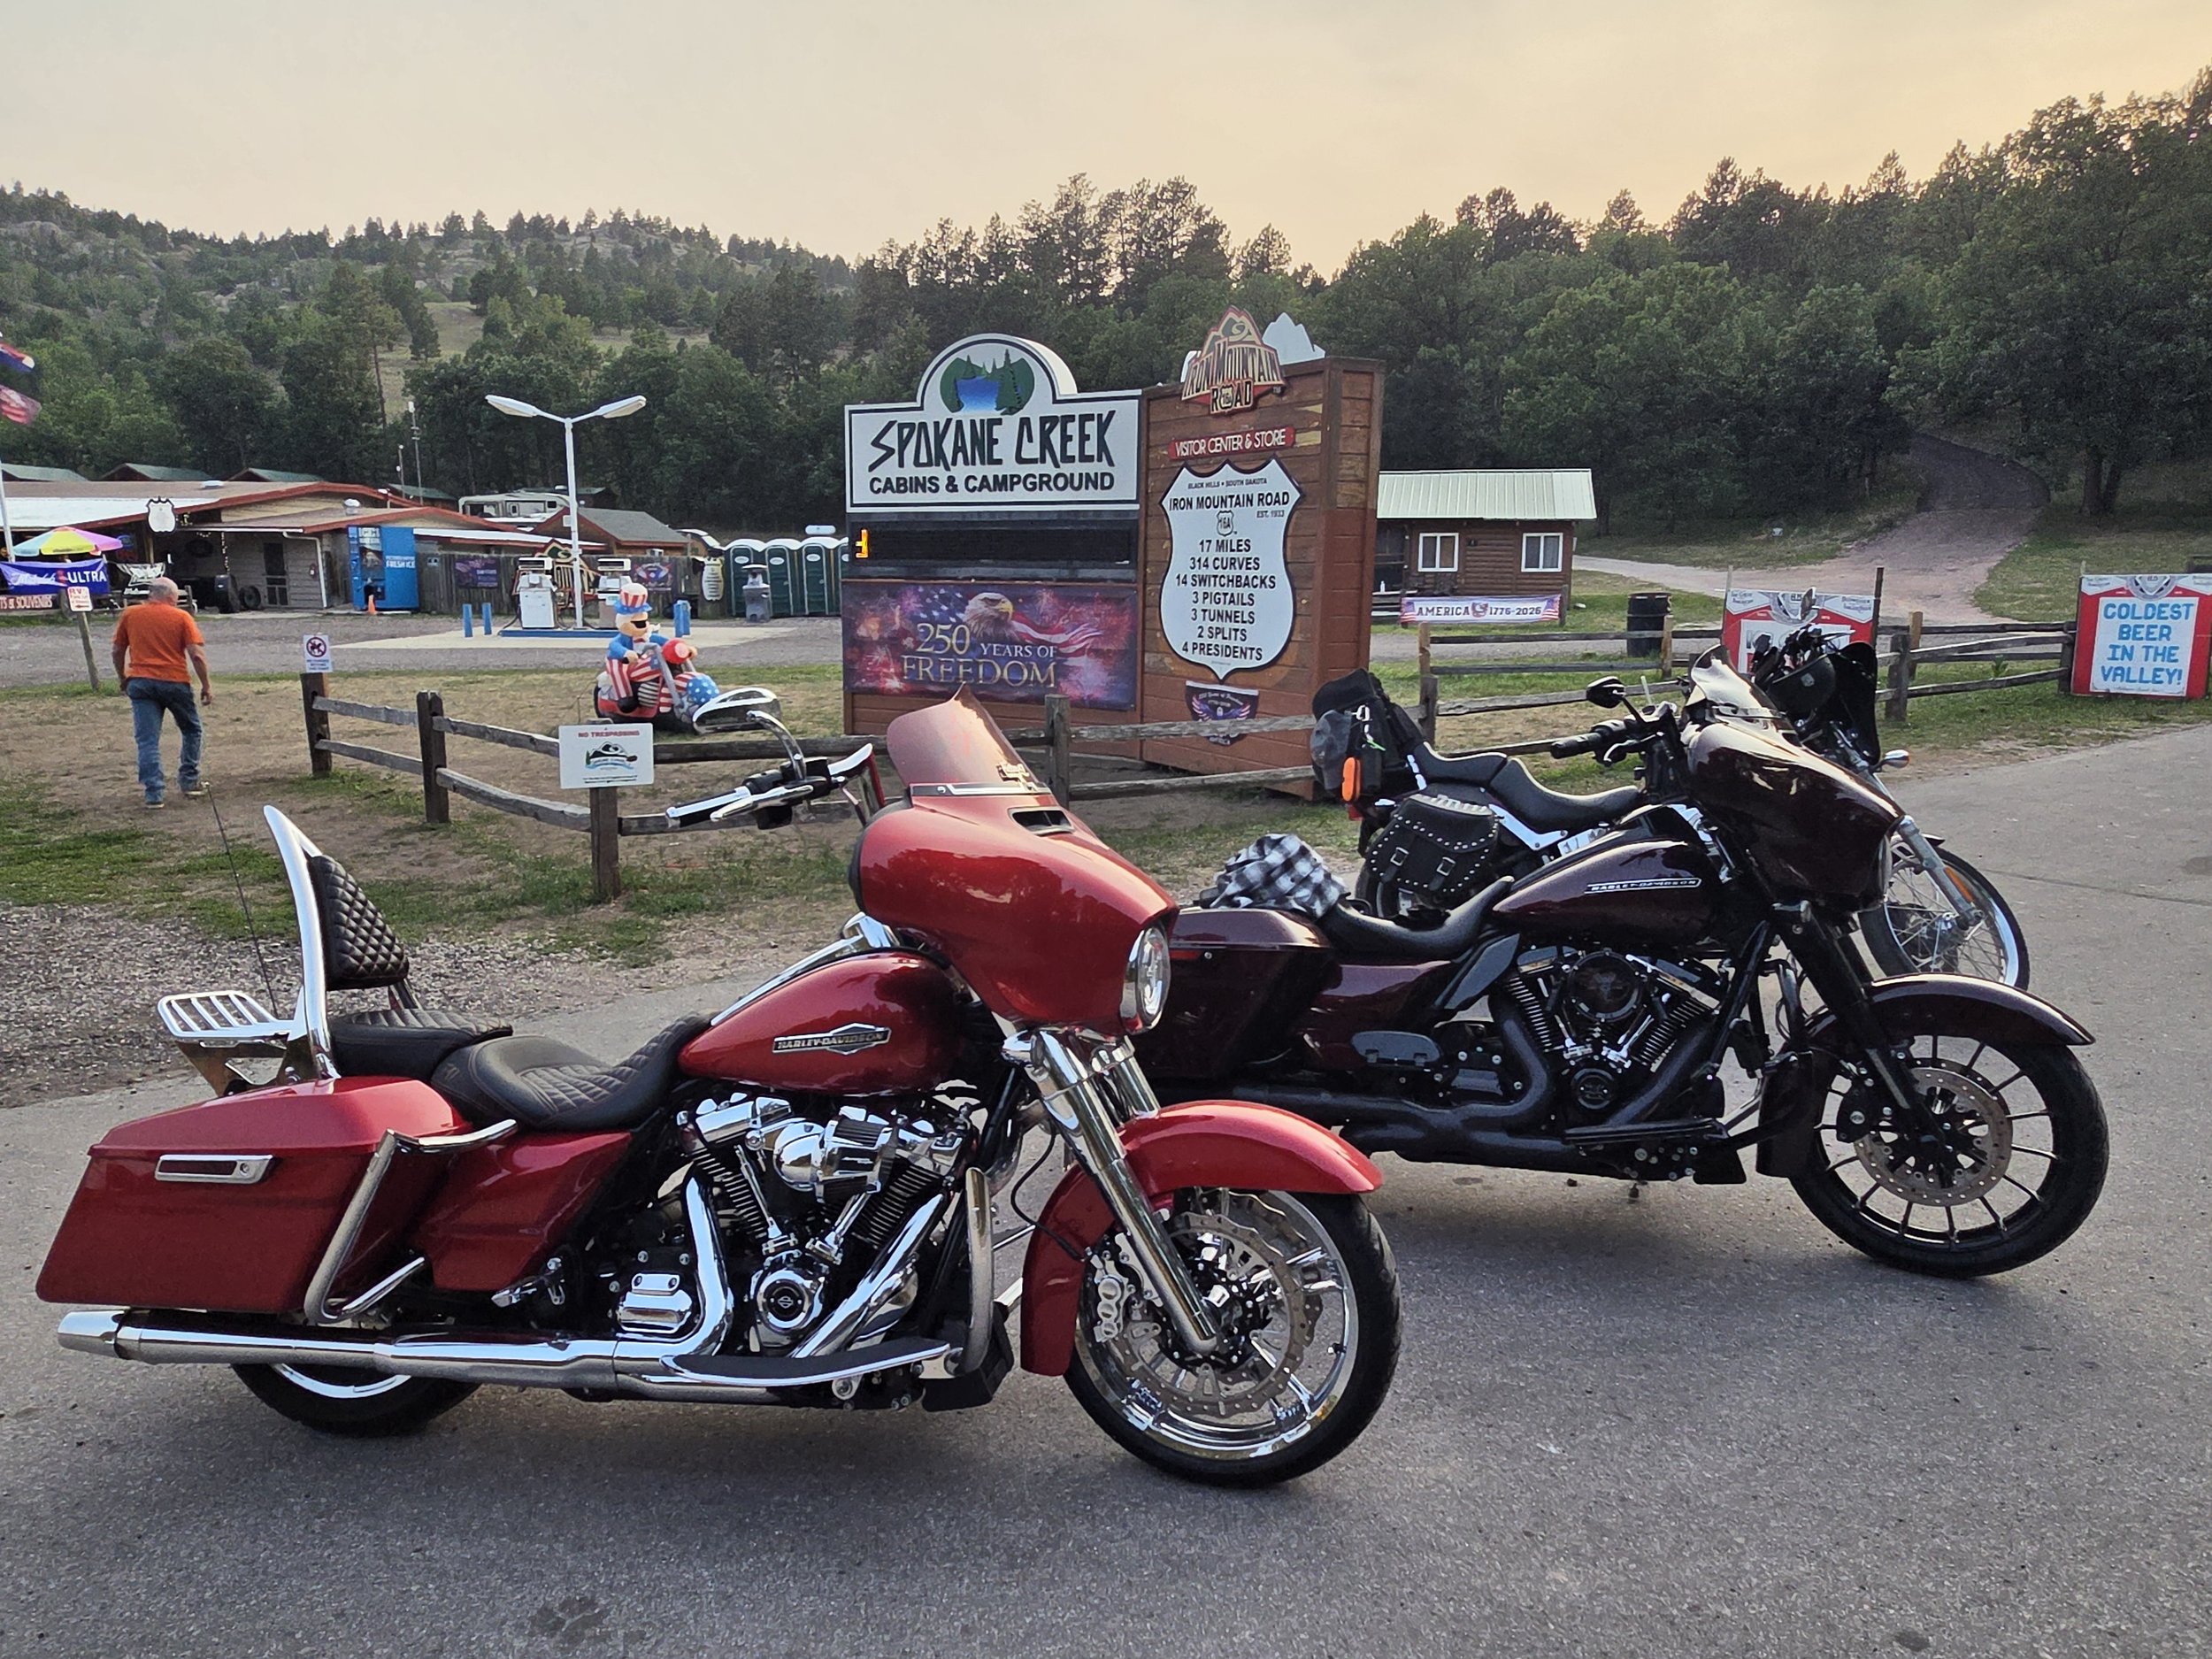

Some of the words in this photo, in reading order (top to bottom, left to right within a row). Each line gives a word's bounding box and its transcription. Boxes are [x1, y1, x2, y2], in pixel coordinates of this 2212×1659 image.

[868, 417, 1003, 472] SPOKANE
[1015, 410, 1117, 469] CREEK
[1175, 438, 1207, 457] VISITOR
[1208, 434, 1242, 454] CENTER
[1245, 433, 1253, 449] &
[1254, 428, 1286, 449] STORE
[869, 475, 940, 495] CABINS
[945, 474, 959, 494] &
[964, 472, 1115, 494] CAMPGROUND
[1169, 496, 1194, 511] IRON
[1196, 493, 1254, 510] MOUNTAIN
[1257, 491, 1290, 507] ROAD
[1199, 540, 1212, 553] 17
[1215, 539, 1251, 553] MILES
[1189, 557, 1210, 571] 314
[1212, 557, 1260, 571] CURVES
[67, 570, 107, 583] ULTRA
[1176, 574, 1187, 588] 14
[1191, 573, 1276, 589] SWITCHBACKS
[1192, 591, 1199, 604] 3
[1202, 591, 1255, 606] PIGTAILS
[1191, 608, 1198, 621] 3
[1201, 608, 1256, 625] TUNNELS
[1417, 606, 1470, 617] AMERICA
[1489, 606, 1541, 616] 1776-2026
[2103, 603, 2194, 620] COLDEST
[916, 622, 972, 656] 250
[1197, 626, 1204, 639] 2
[1207, 626, 1248, 641] SPLITS
[2117, 624, 2172, 641] BEER
[979, 643, 1033, 658] YEARS
[1036, 645, 1058, 658] OF
[1182, 641, 1189, 653] 4
[1192, 642, 1263, 661] PRESIDENTS
[2107, 644, 2134, 662] IN
[2141, 645, 2179, 663] THE
[900, 655, 1058, 688] FREEDOM
[2101, 665, 2183, 686] VALLEY!
[777, 1033, 885, 1049] HARLEY-DAVIDSON
